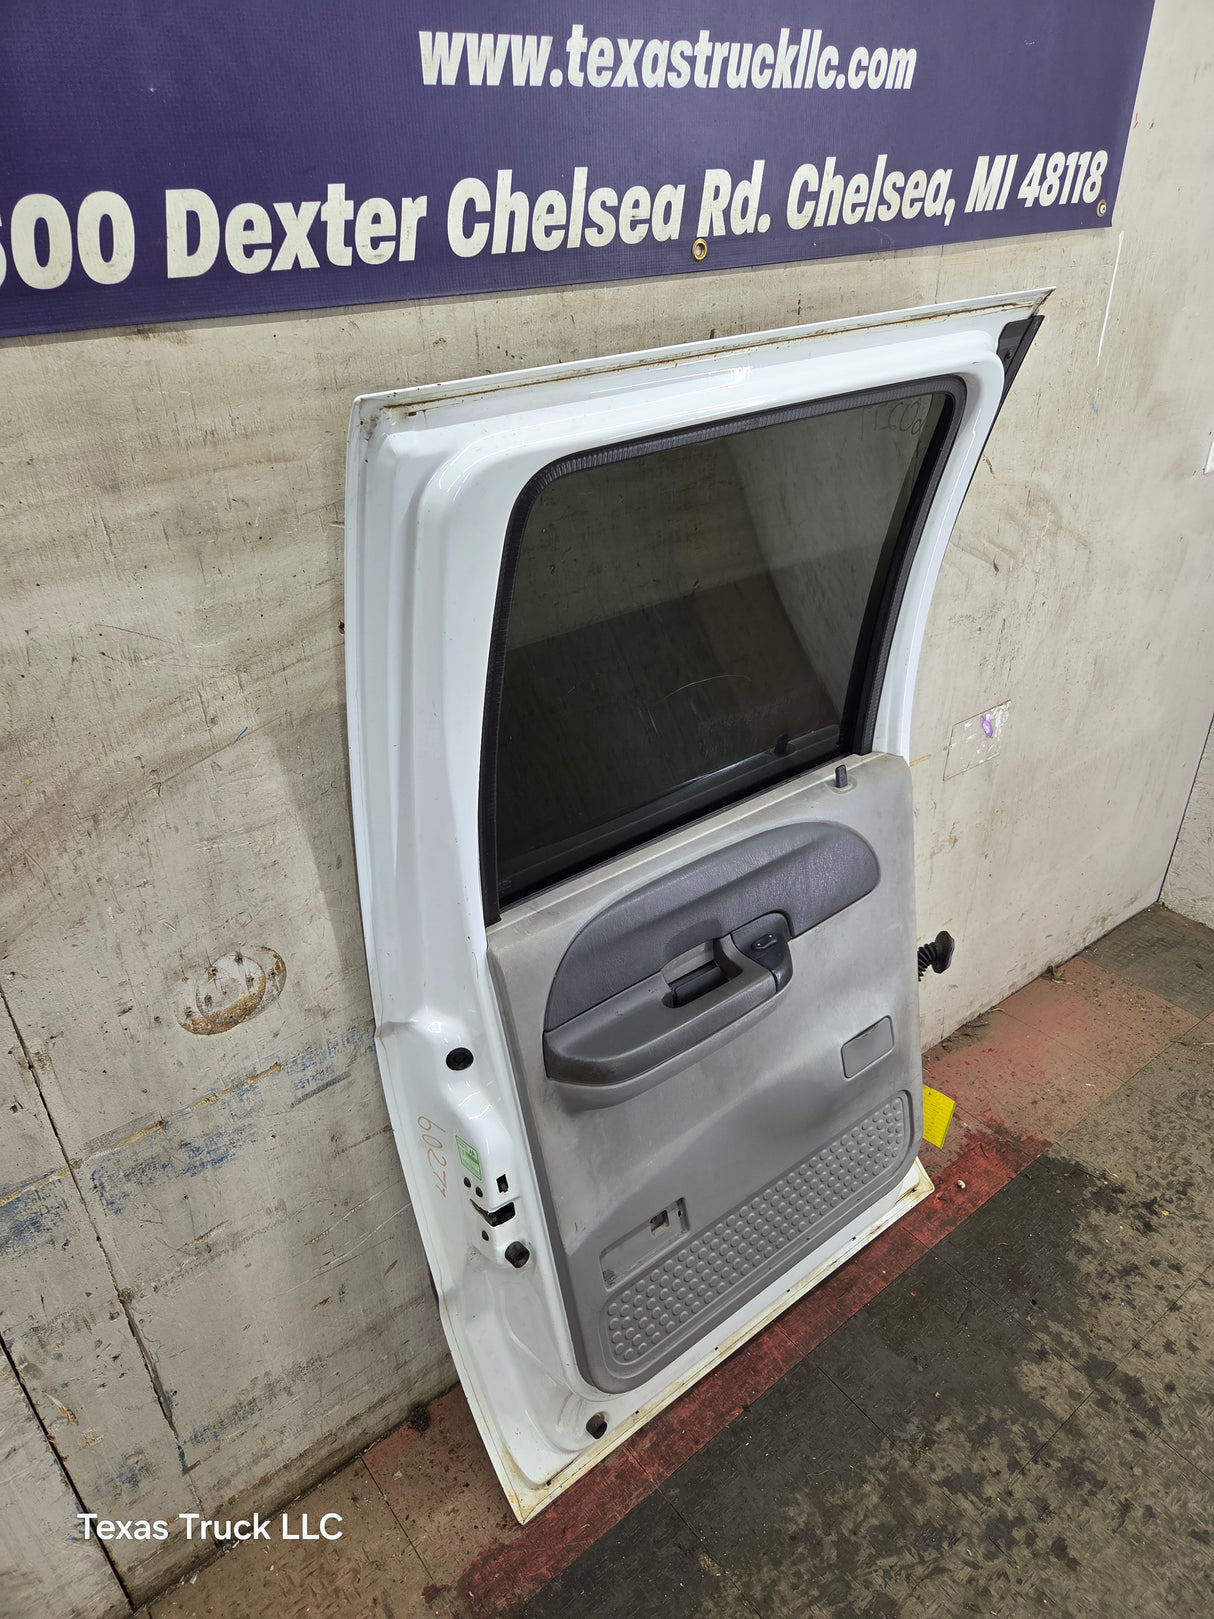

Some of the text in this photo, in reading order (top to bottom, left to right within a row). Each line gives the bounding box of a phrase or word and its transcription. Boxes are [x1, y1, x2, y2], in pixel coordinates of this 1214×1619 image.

[419, 24, 917, 90] www.texastruckllc.com
[0, 150, 1109, 290] 00 Dexter Chelsea Rd. Chelsea, MI 48118
